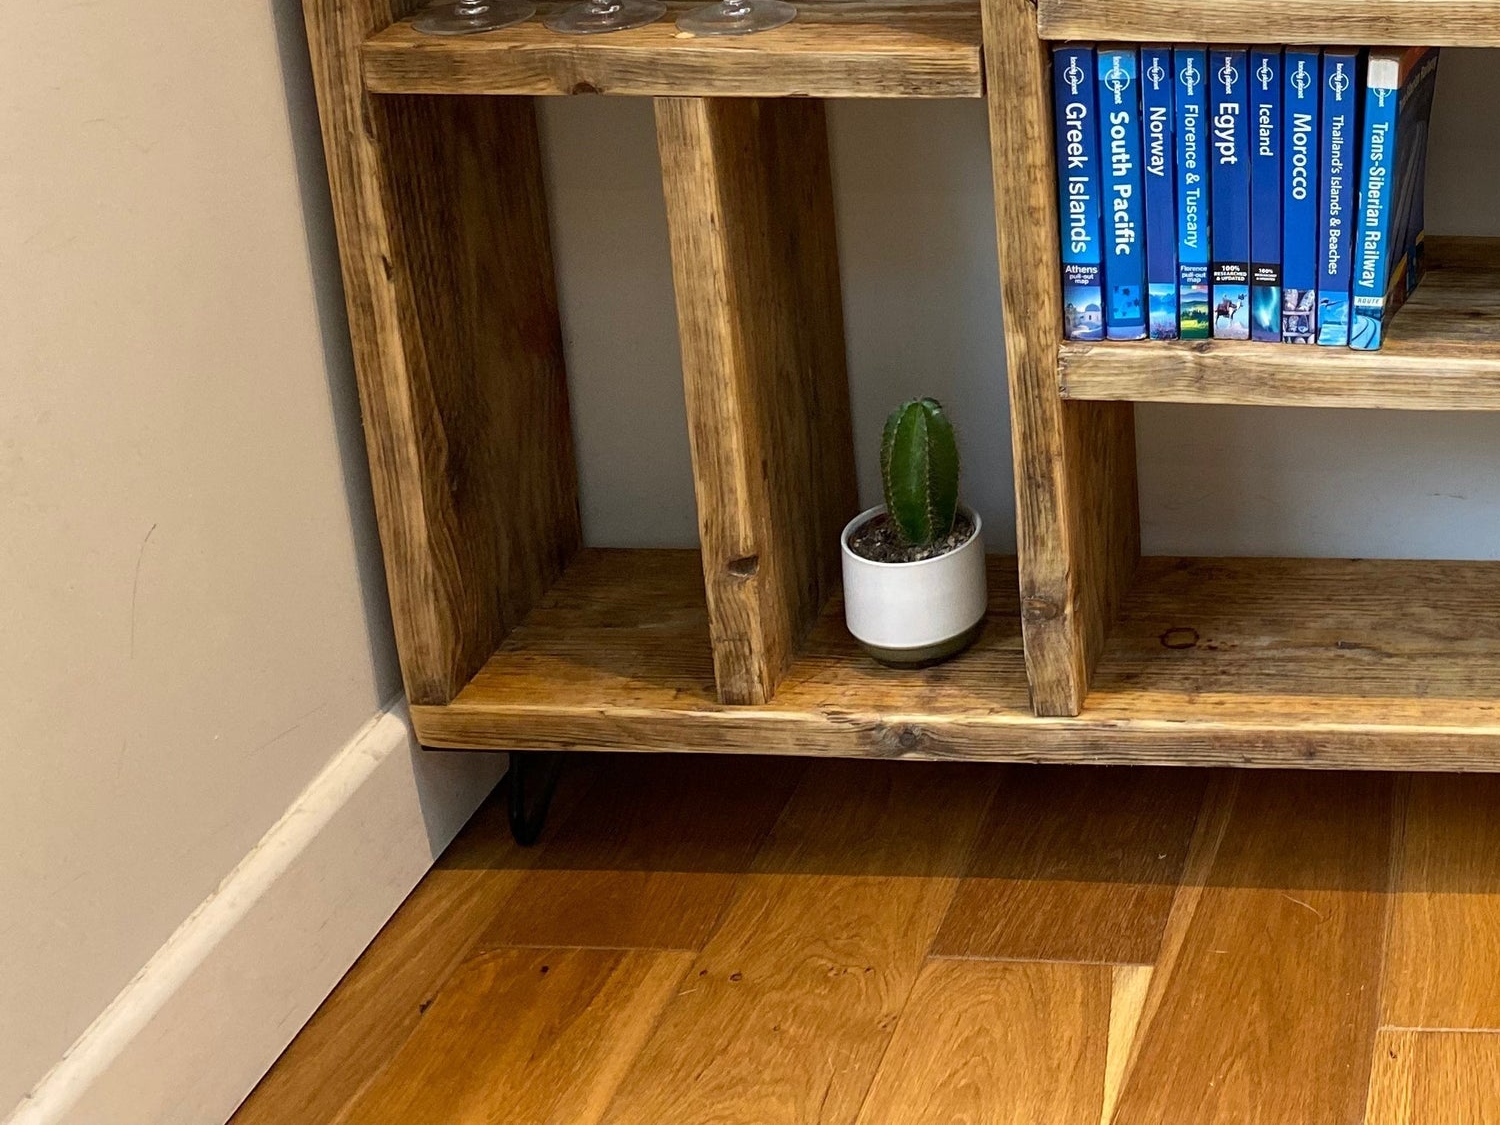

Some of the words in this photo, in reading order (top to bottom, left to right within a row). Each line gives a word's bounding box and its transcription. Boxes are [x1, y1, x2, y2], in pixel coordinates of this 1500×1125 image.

[1069, 57, 1078, 75] lonely
[1111, 56, 1122, 80] lonely
[1151, 58, 1160, 73] lonely
[1185, 58, 1194, 76] lonely
[1223, 57, 1232, 75] lonely
[1261, 59, 1269, 74] lonely
[1296, 61, 1305, 79] lonely
[1334, 63, 1344, 81] lonely
[1069, 75, 1078, 95] planet
[1112, 80, 1123, 105] planet
[1152, 73, 1160, 90] planet
[1185, 76, 1194, 96] planet
[1224, 75, 1232, 95] planet
[1261, 74, 1269, 90] planet
[1296, 79, 1305, 99] planet
[1335, 81, 1343, 101] planet
[1065, 102, 1088, 169] Greek
[1184, 104, 1199, 169] Florence
[1214, 102, 1240, 165] Egypt
[1259, 103, 1274, 156] Iceland
[1110, 111, 1132, 176] South
[1147, 107, 1166, 176] Norway
[1330, 115, 1344, 178] Thailand's
[1292, 113, 1312, 200] Morocco
[1185, 173, 1200, 184] &
[1366, 122, 1389, 226] Trans-Siberian
[1329, 178, 1342, 215] Islands
[1068, 176, 1092, 254] Islands
[1112, 184, 1135, 255] Pacific
[1184, 188, 1200, 249] Tuscany
[1329, 218, 1341, 227] &
[1328, 229, 1341, 275] Beaches
[1358, 231, 1382, 288] Railway
[1065, 265, 1098, 274] Athens
